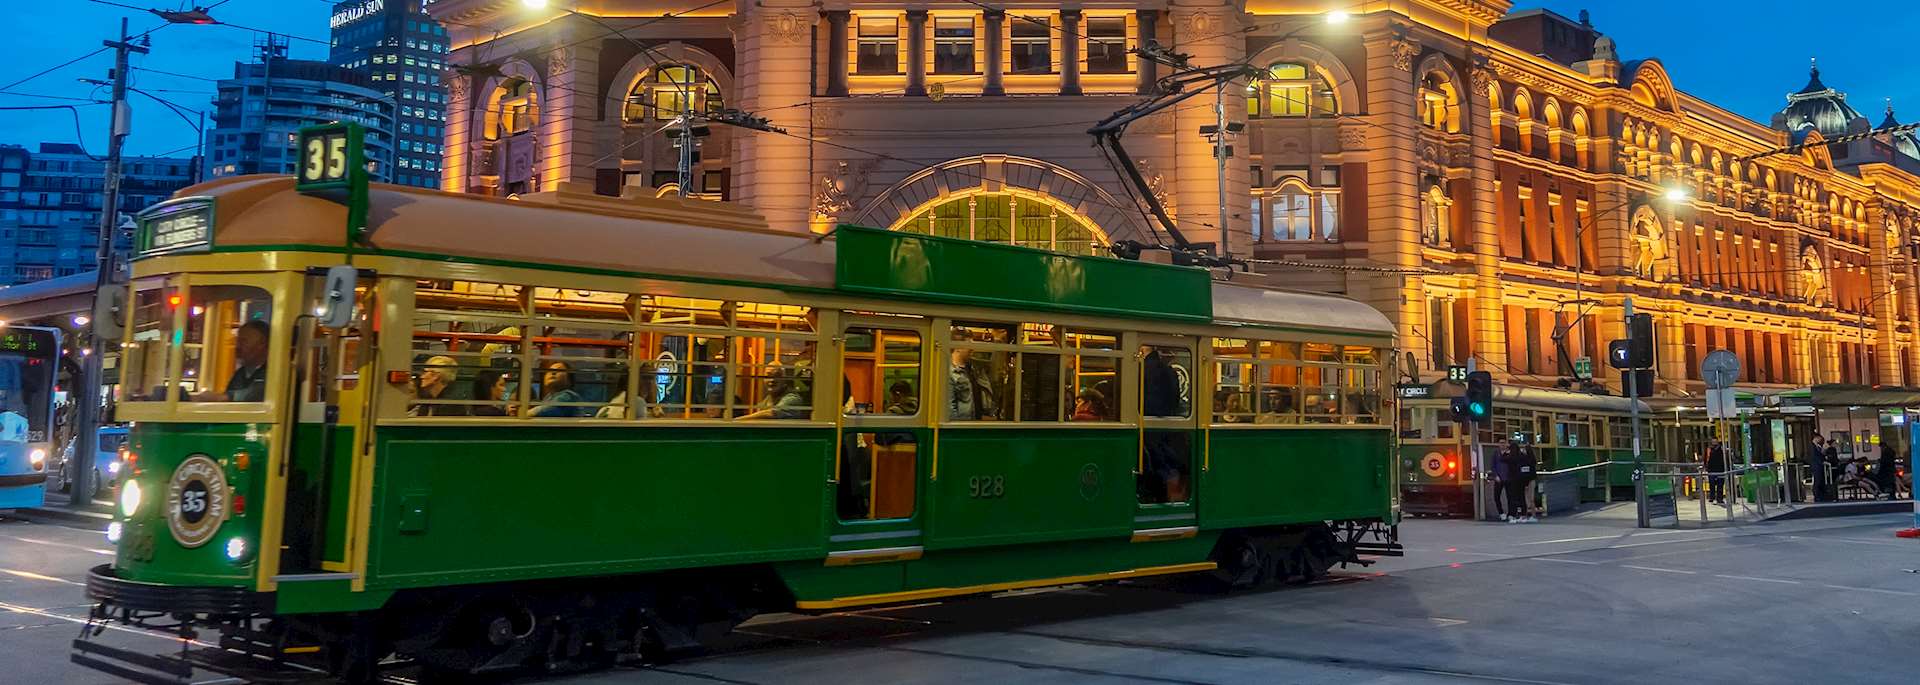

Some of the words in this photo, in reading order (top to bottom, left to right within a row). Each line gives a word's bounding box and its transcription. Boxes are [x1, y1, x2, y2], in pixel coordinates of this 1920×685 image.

[330, 7, 364, 28] HERALD
[365, 0, 384, 15] SUN
[305, 137, 346, 180] 35
[1450, 367, 1466, 380] 35
[1406, 387, 1427, 395] CIRCLE
[179, 464, 214, 481] CIRCLE
[209, 475, 223, 517] TRAM
[969, 475, 1005, 497] 928
[182, 490, 207, 513] 35
